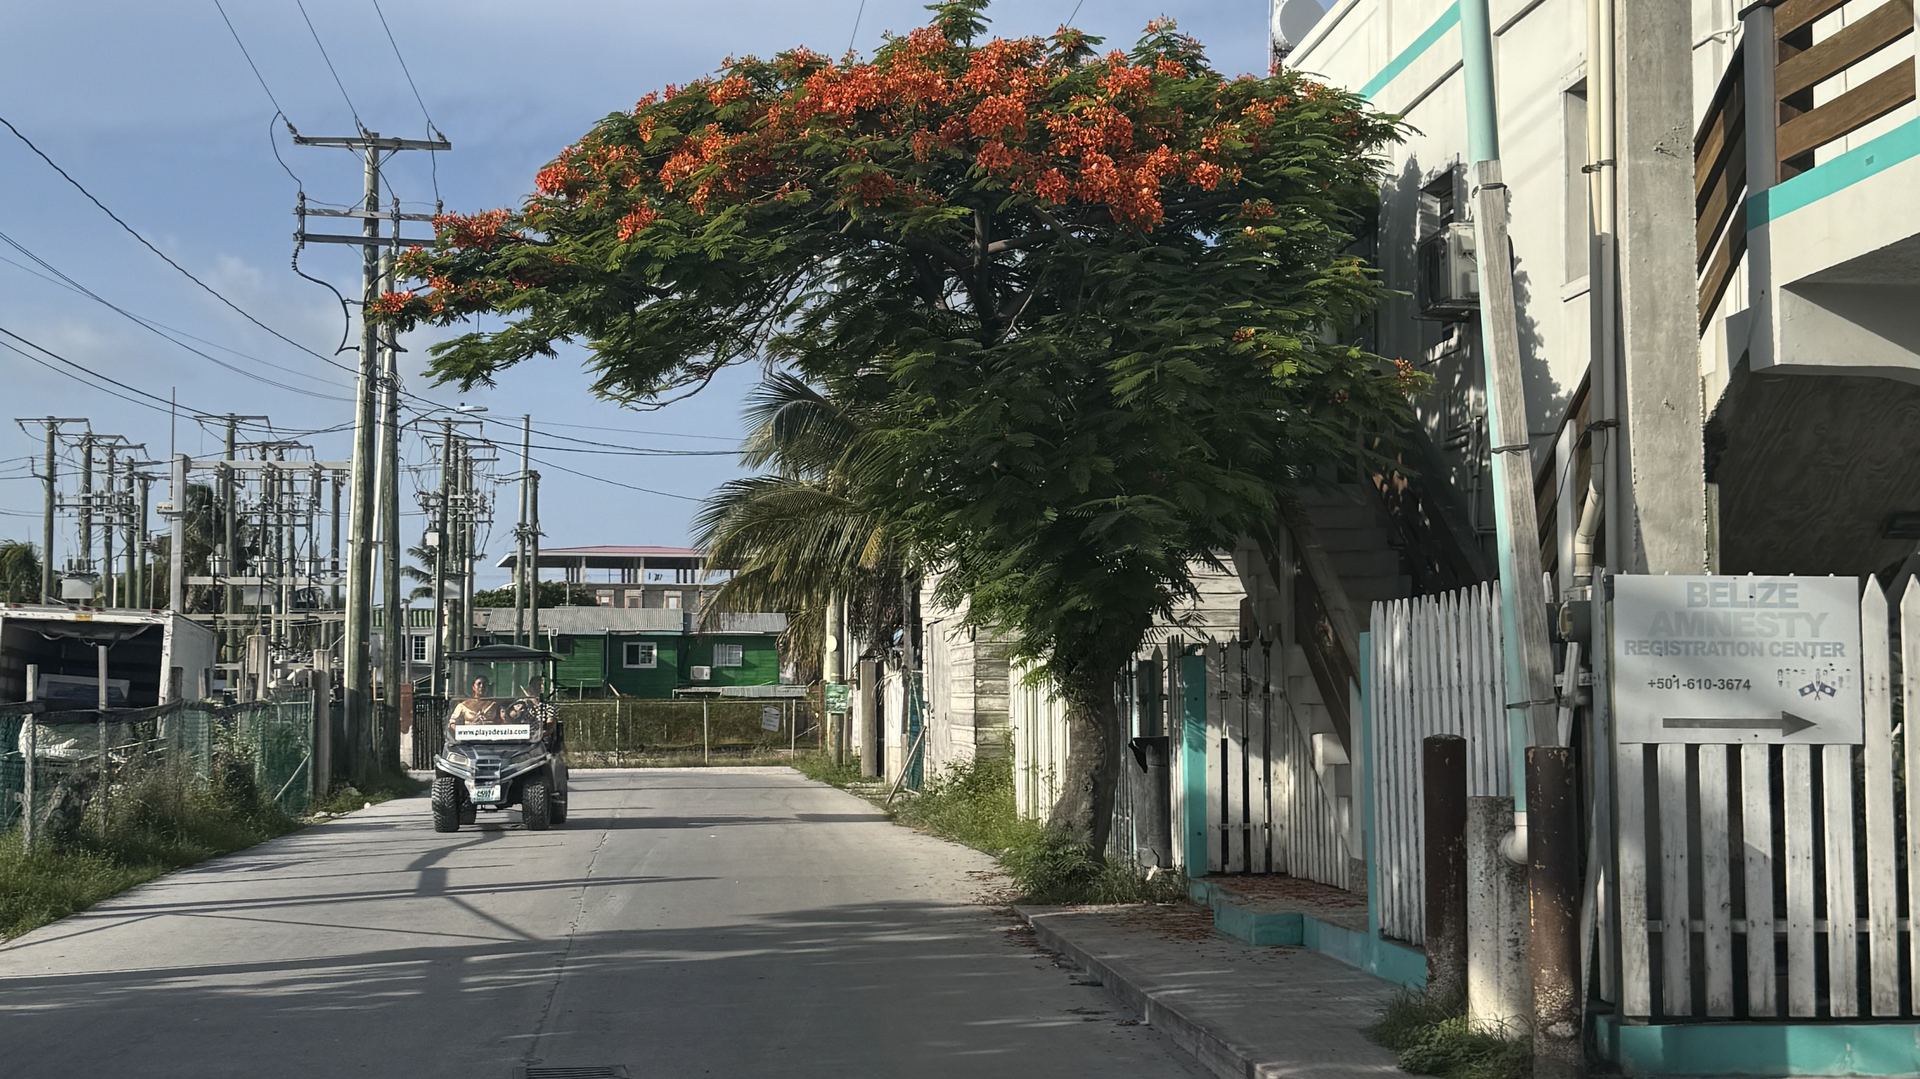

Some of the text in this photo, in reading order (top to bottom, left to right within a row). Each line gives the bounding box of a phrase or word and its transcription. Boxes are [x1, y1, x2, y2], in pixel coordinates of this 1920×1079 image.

[1687, 581, 1799, 609] BELIZE
[1648, 611, 1829, 639] AMNESTY
[1624, 640, 1846, 658] REGISTRATION CENTER
[1647, 678, 1752, 691] +501-610-3674
